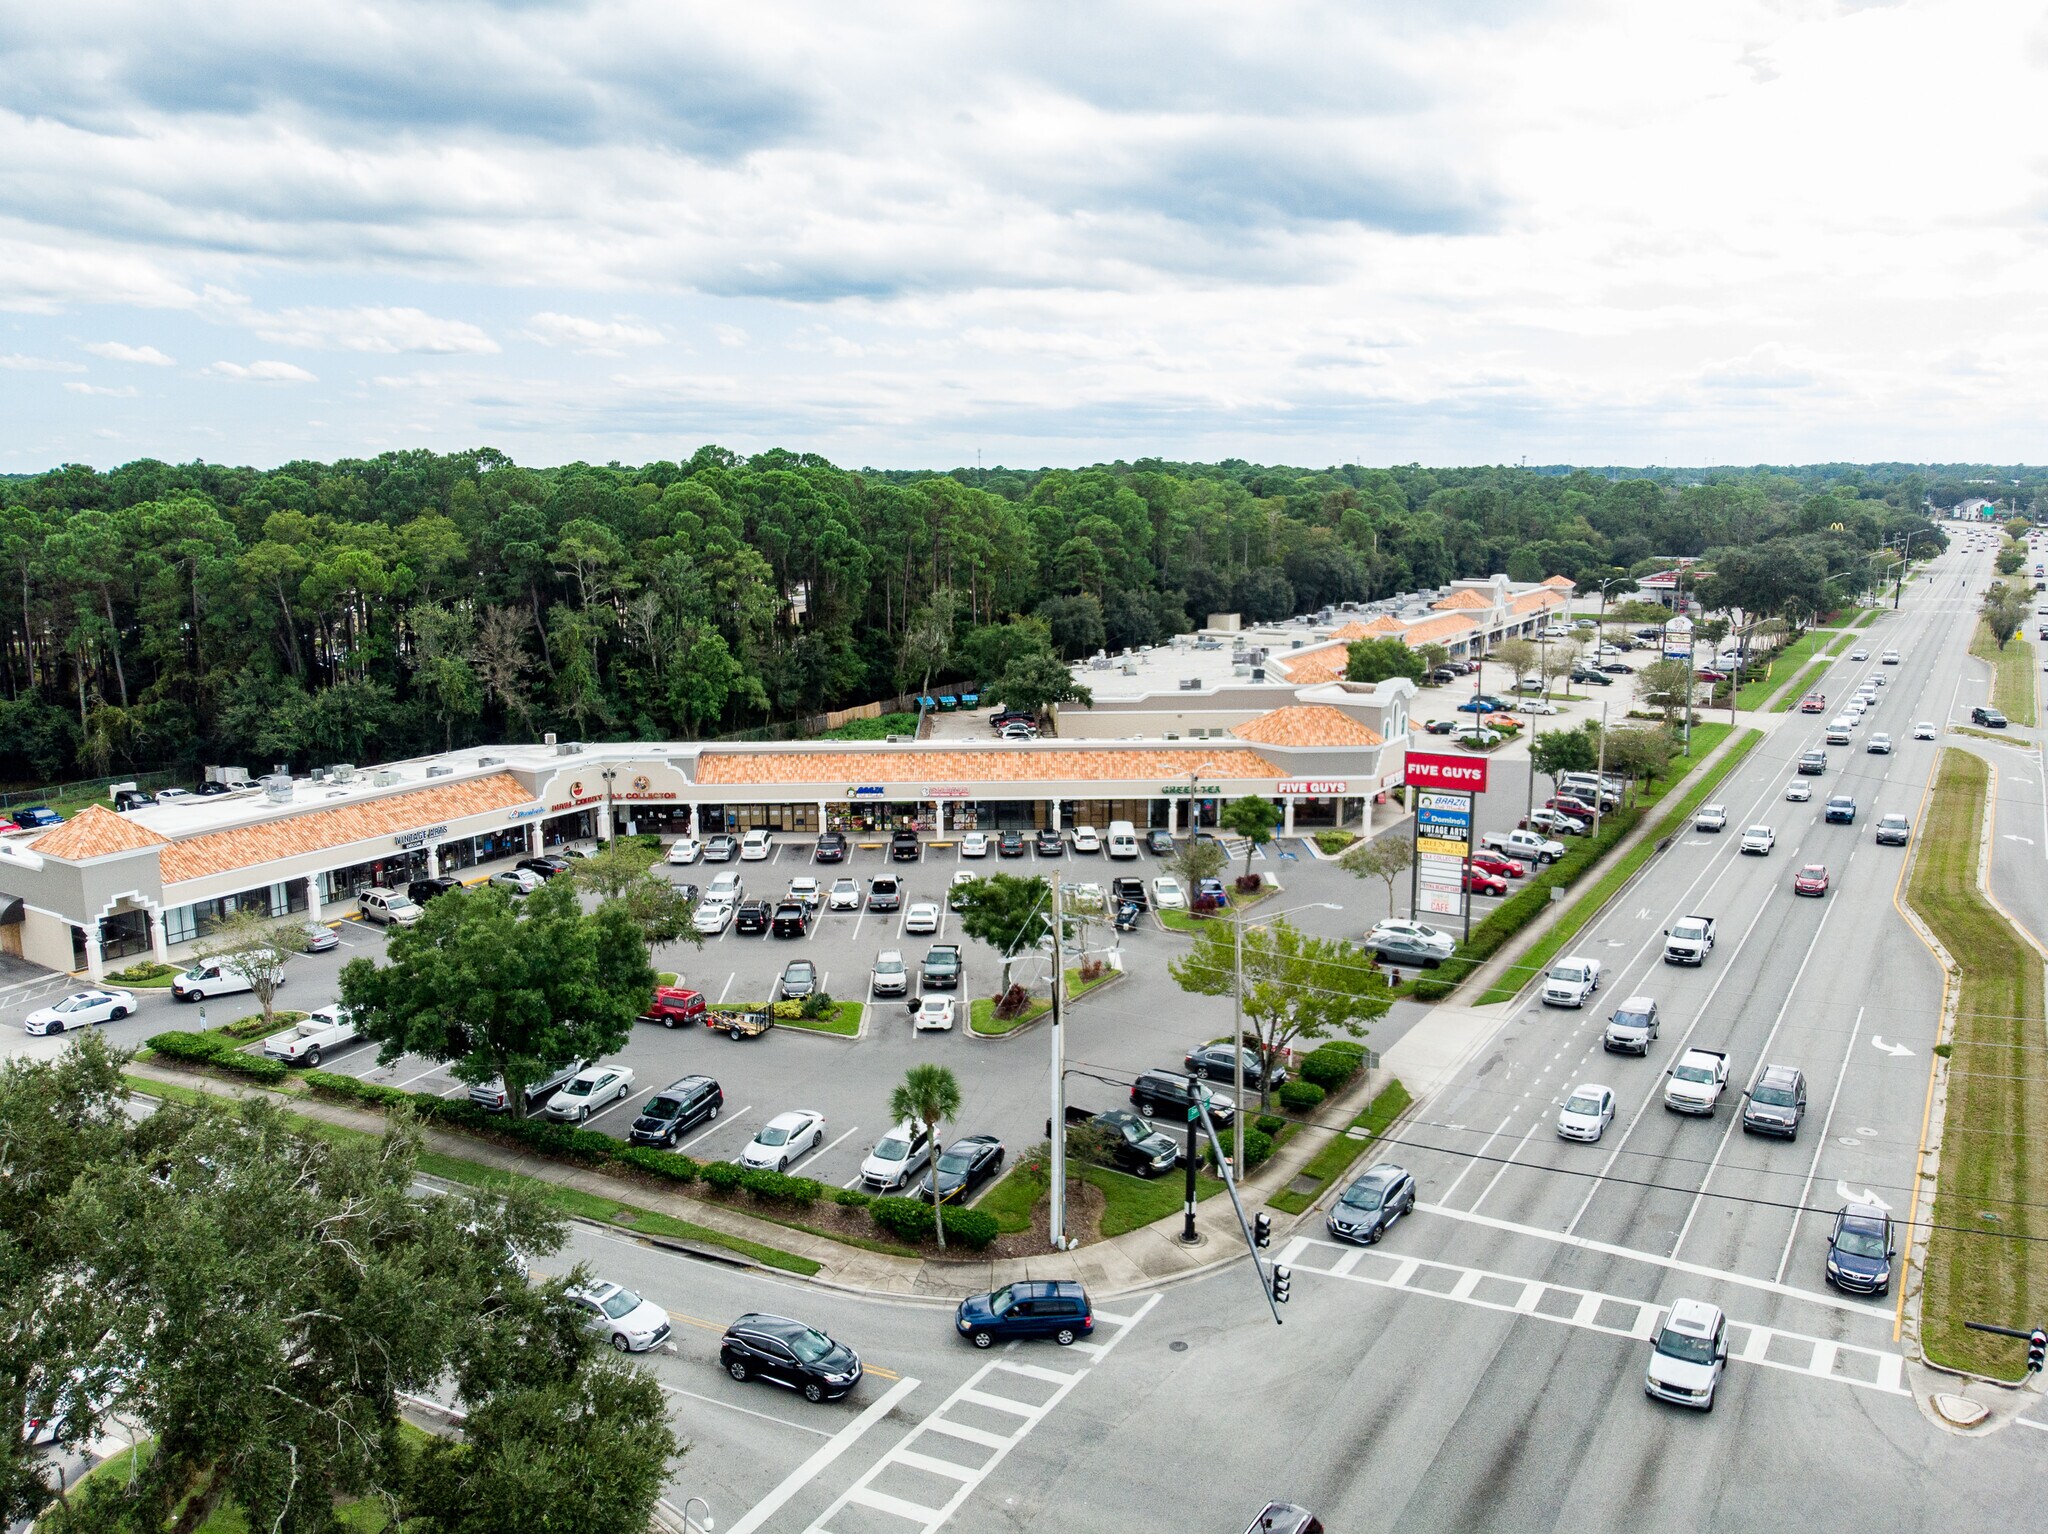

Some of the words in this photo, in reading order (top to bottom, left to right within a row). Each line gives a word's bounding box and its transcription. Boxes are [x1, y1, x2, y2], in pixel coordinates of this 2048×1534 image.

[1407, 763, 1439, 776] FIVE
[1441, 766, 1482, 780] GUYS
[1278, 782, 1307, 793] FIVE
[1309, 782, 1346, 793] GUYS
[551, 801, 572, 812] DUVAL
[575, 794, 603, 806] COUNTY
[625, 792, 677, 800] COLLECTOR
[1434, 796, 1467, 807] BRAZIL
[1431, 815, 1466, 826] Domino's
[394, 830, 427, 846] VINTAGE
[427, 825, 448, 839] ARTS
[1419, 824, 1449, 835] VINTAGE
[1449, 827, 1467, 837] ARTS
[1418, 840, 1446, 848] GREEN
[1449, 842, 1467, 850] TEA
[1433, 855, 1461, 863] COLLECTOR
[1430, 902, 1449, 912] CAFE
